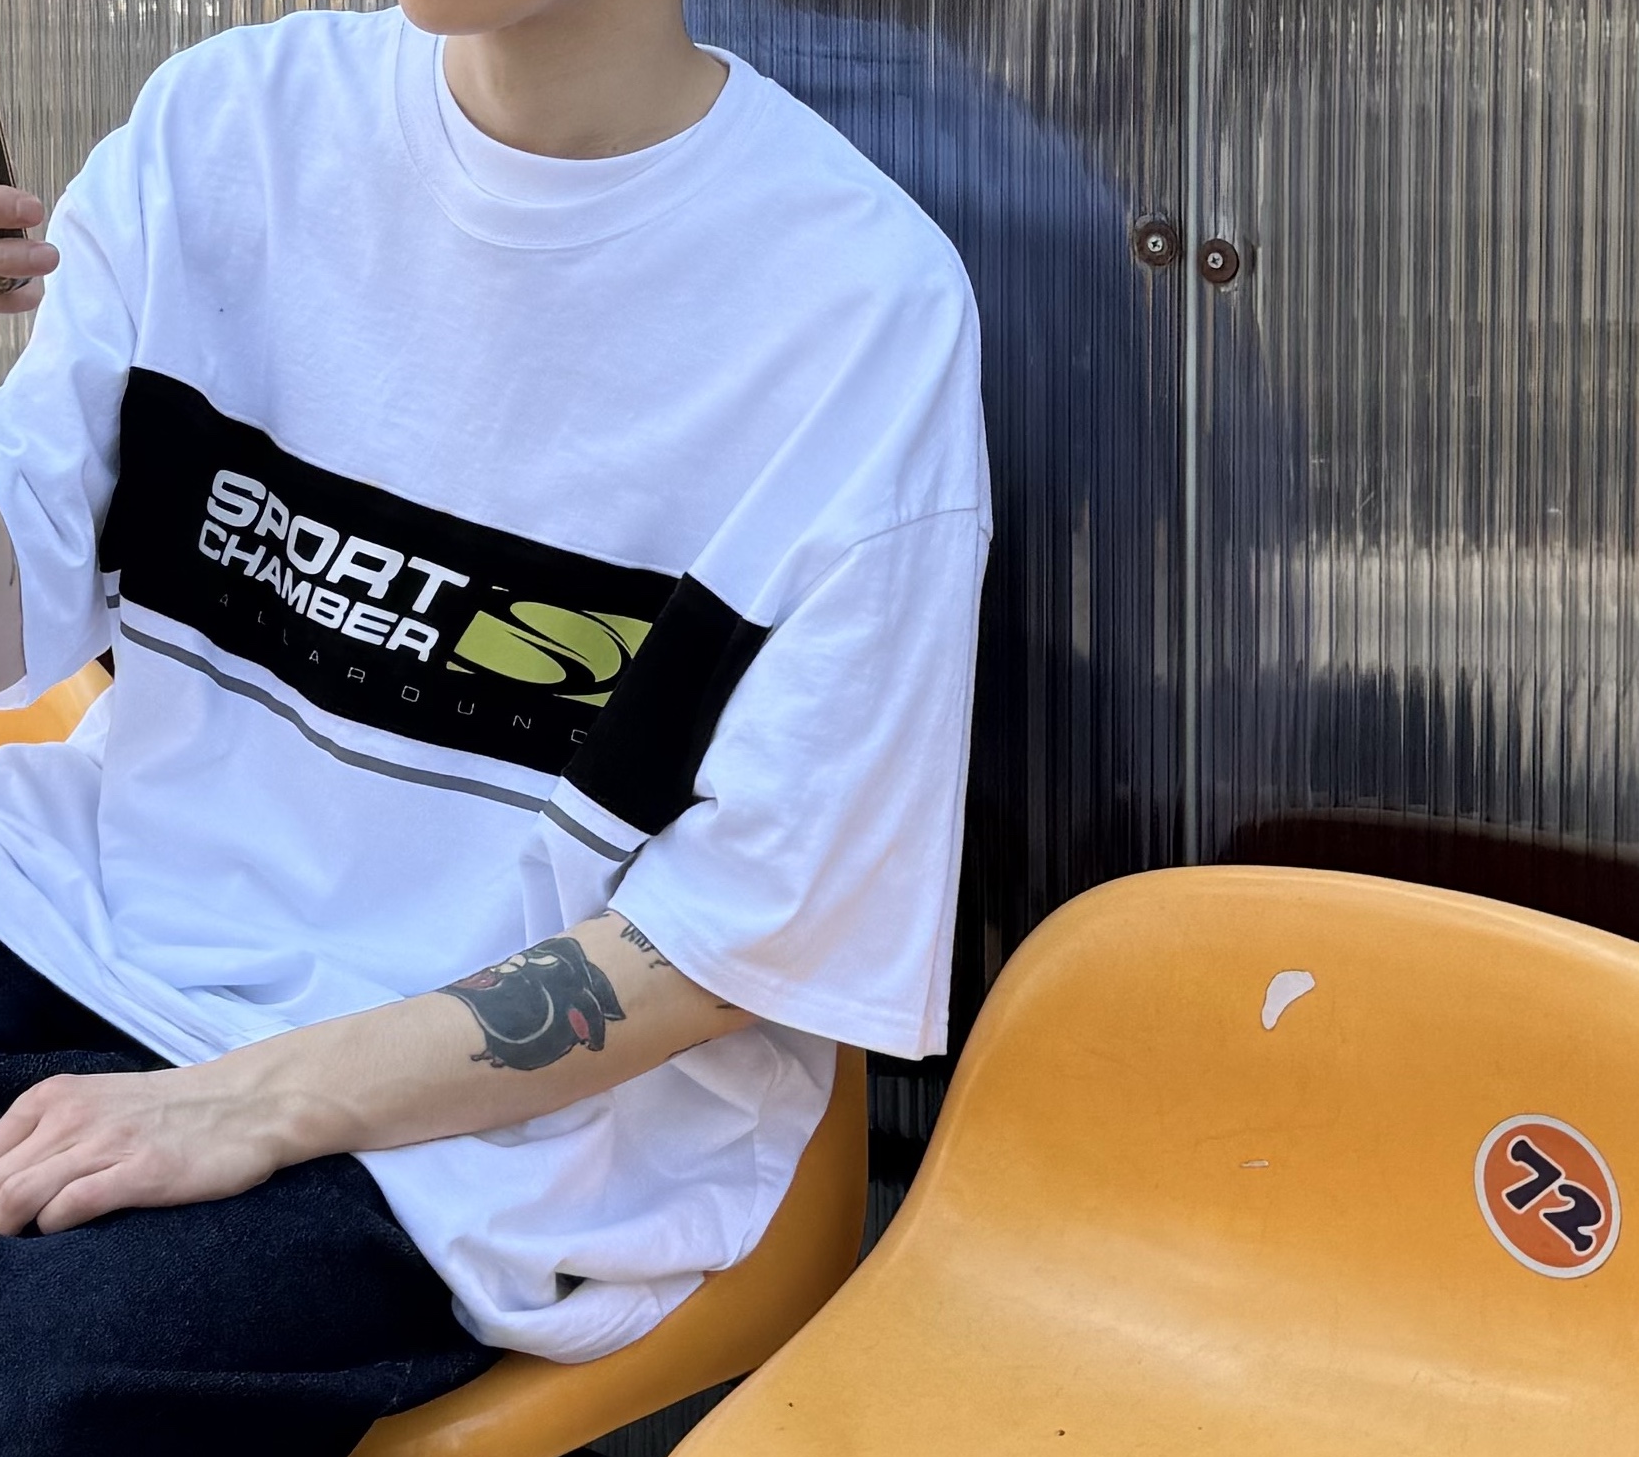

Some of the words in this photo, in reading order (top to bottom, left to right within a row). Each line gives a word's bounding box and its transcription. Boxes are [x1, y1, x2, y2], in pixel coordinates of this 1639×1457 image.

[198, 519, 440, 662] CHAMBER
[206, 469, 471, 614] SPORT
[1502, 1135, 1605, 1256] 72
